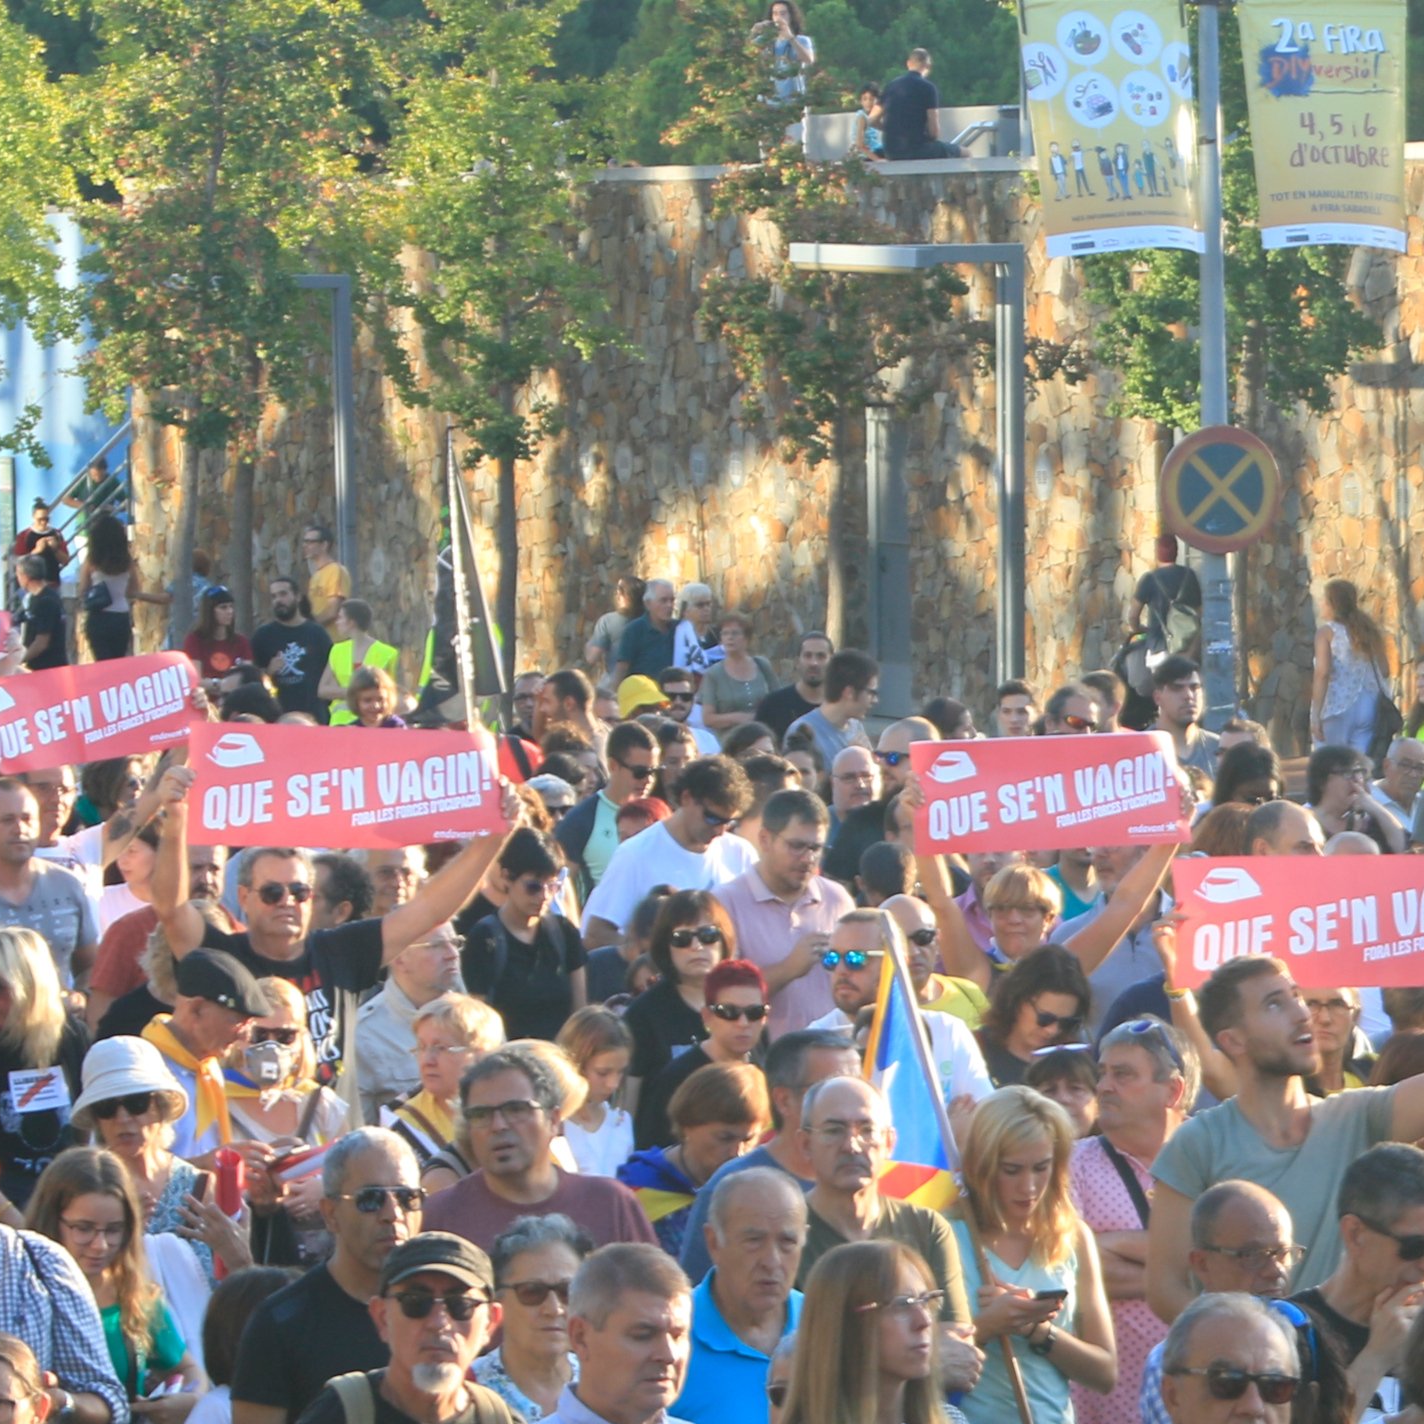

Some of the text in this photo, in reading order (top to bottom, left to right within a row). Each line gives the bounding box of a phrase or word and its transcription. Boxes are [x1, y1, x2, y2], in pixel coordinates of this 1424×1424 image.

[1330, 113, 1343, 135] 5
[1364, 112, 1377, 136] 6
[34, 694, 94, 745] SE'N
[99, 663, 191, 722] VAGIN!
[202, 750, 492, 830] QUE SE'N VAGIN!
[929, 791, 990, 841] QUE
[997, 773, 1066, 824] SE'N
[1192, 914, 1274, 972] QUE
[1288, 894, 1378, 955] SE'N
